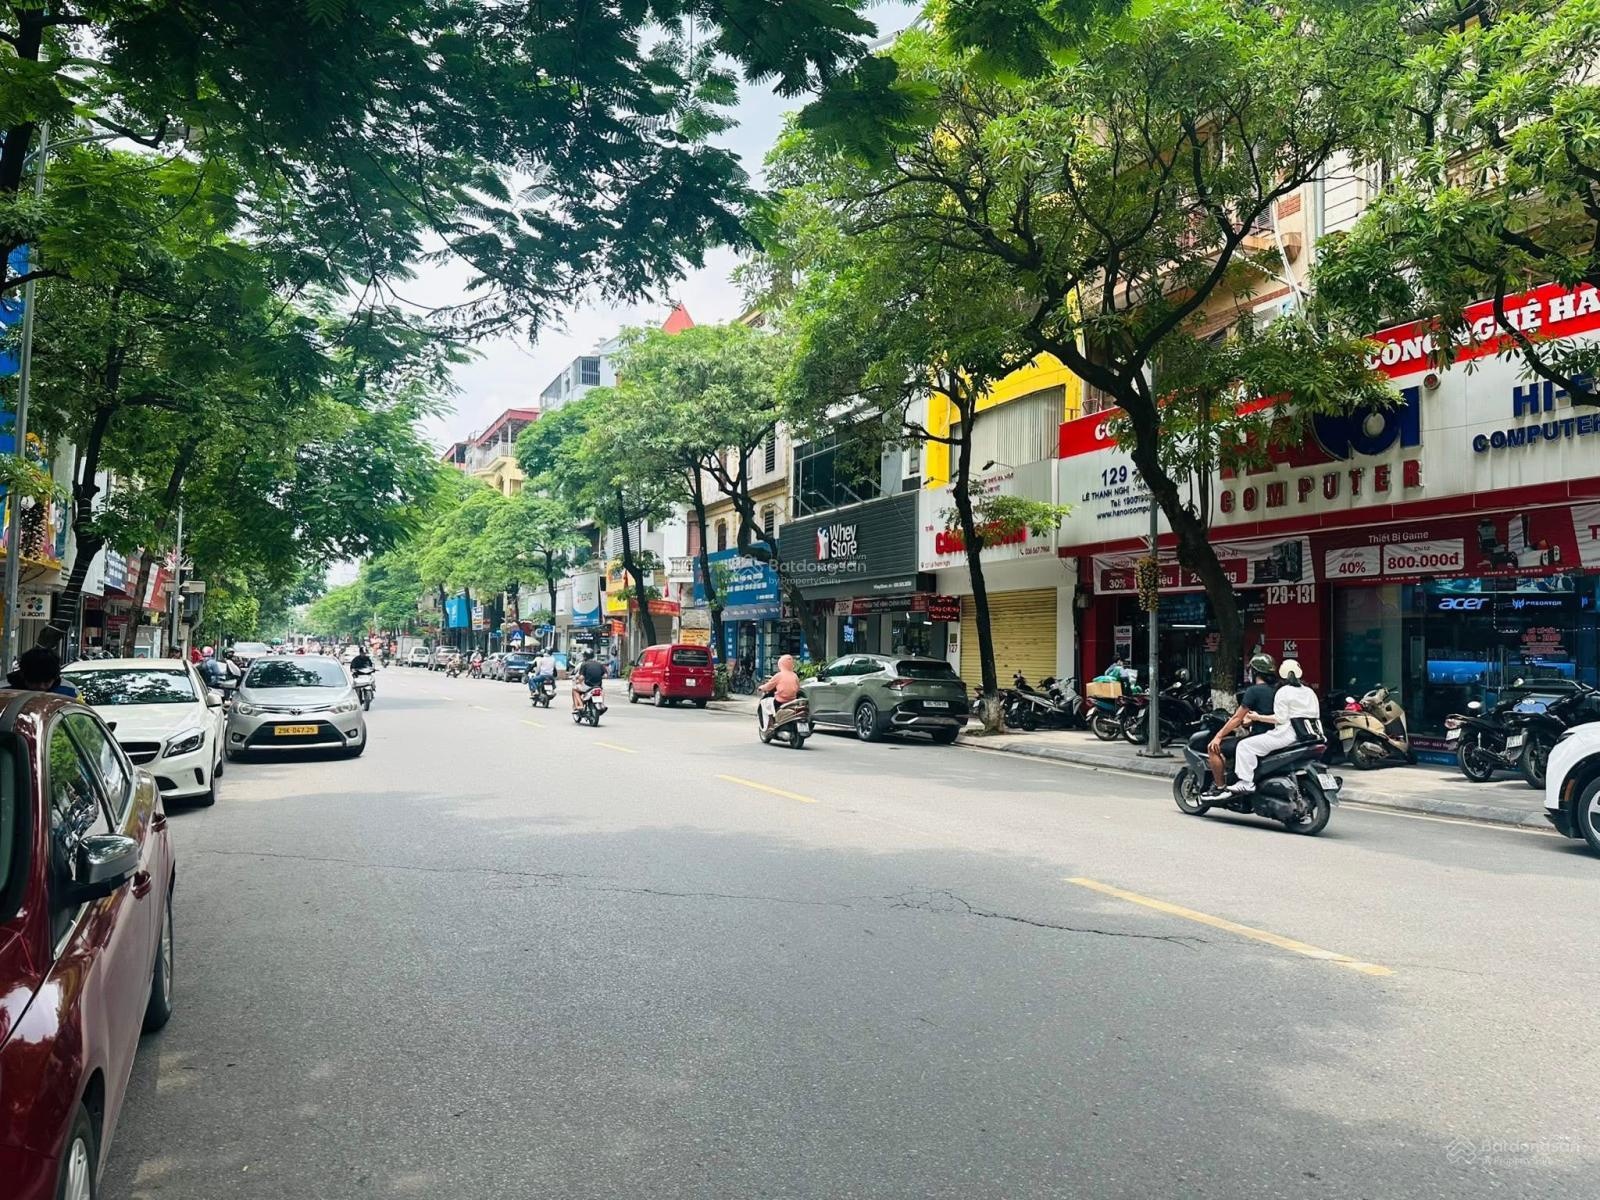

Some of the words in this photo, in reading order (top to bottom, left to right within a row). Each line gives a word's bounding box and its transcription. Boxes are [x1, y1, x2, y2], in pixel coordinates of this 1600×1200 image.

[1102, 465, 1128, 487] 129
[1220, 459, 1425, 514] COMPUTER
[1091, 489, 1112, 500] THANH
[829, 524, 857, 541] Whey
[1402, 531, 1429, 541] Game
[831, 539, 857, 559] Store
[1339, 561, 1366, 574] 40%
[1388, 552, 1459, 569] 800.000đ
[1110, 579, 1126, 588] 30%
[1267, 585, 1315, 605] 129+131
[1438, 598, 1489, 610] acer
[1284, 640, 1297, 650] K+
